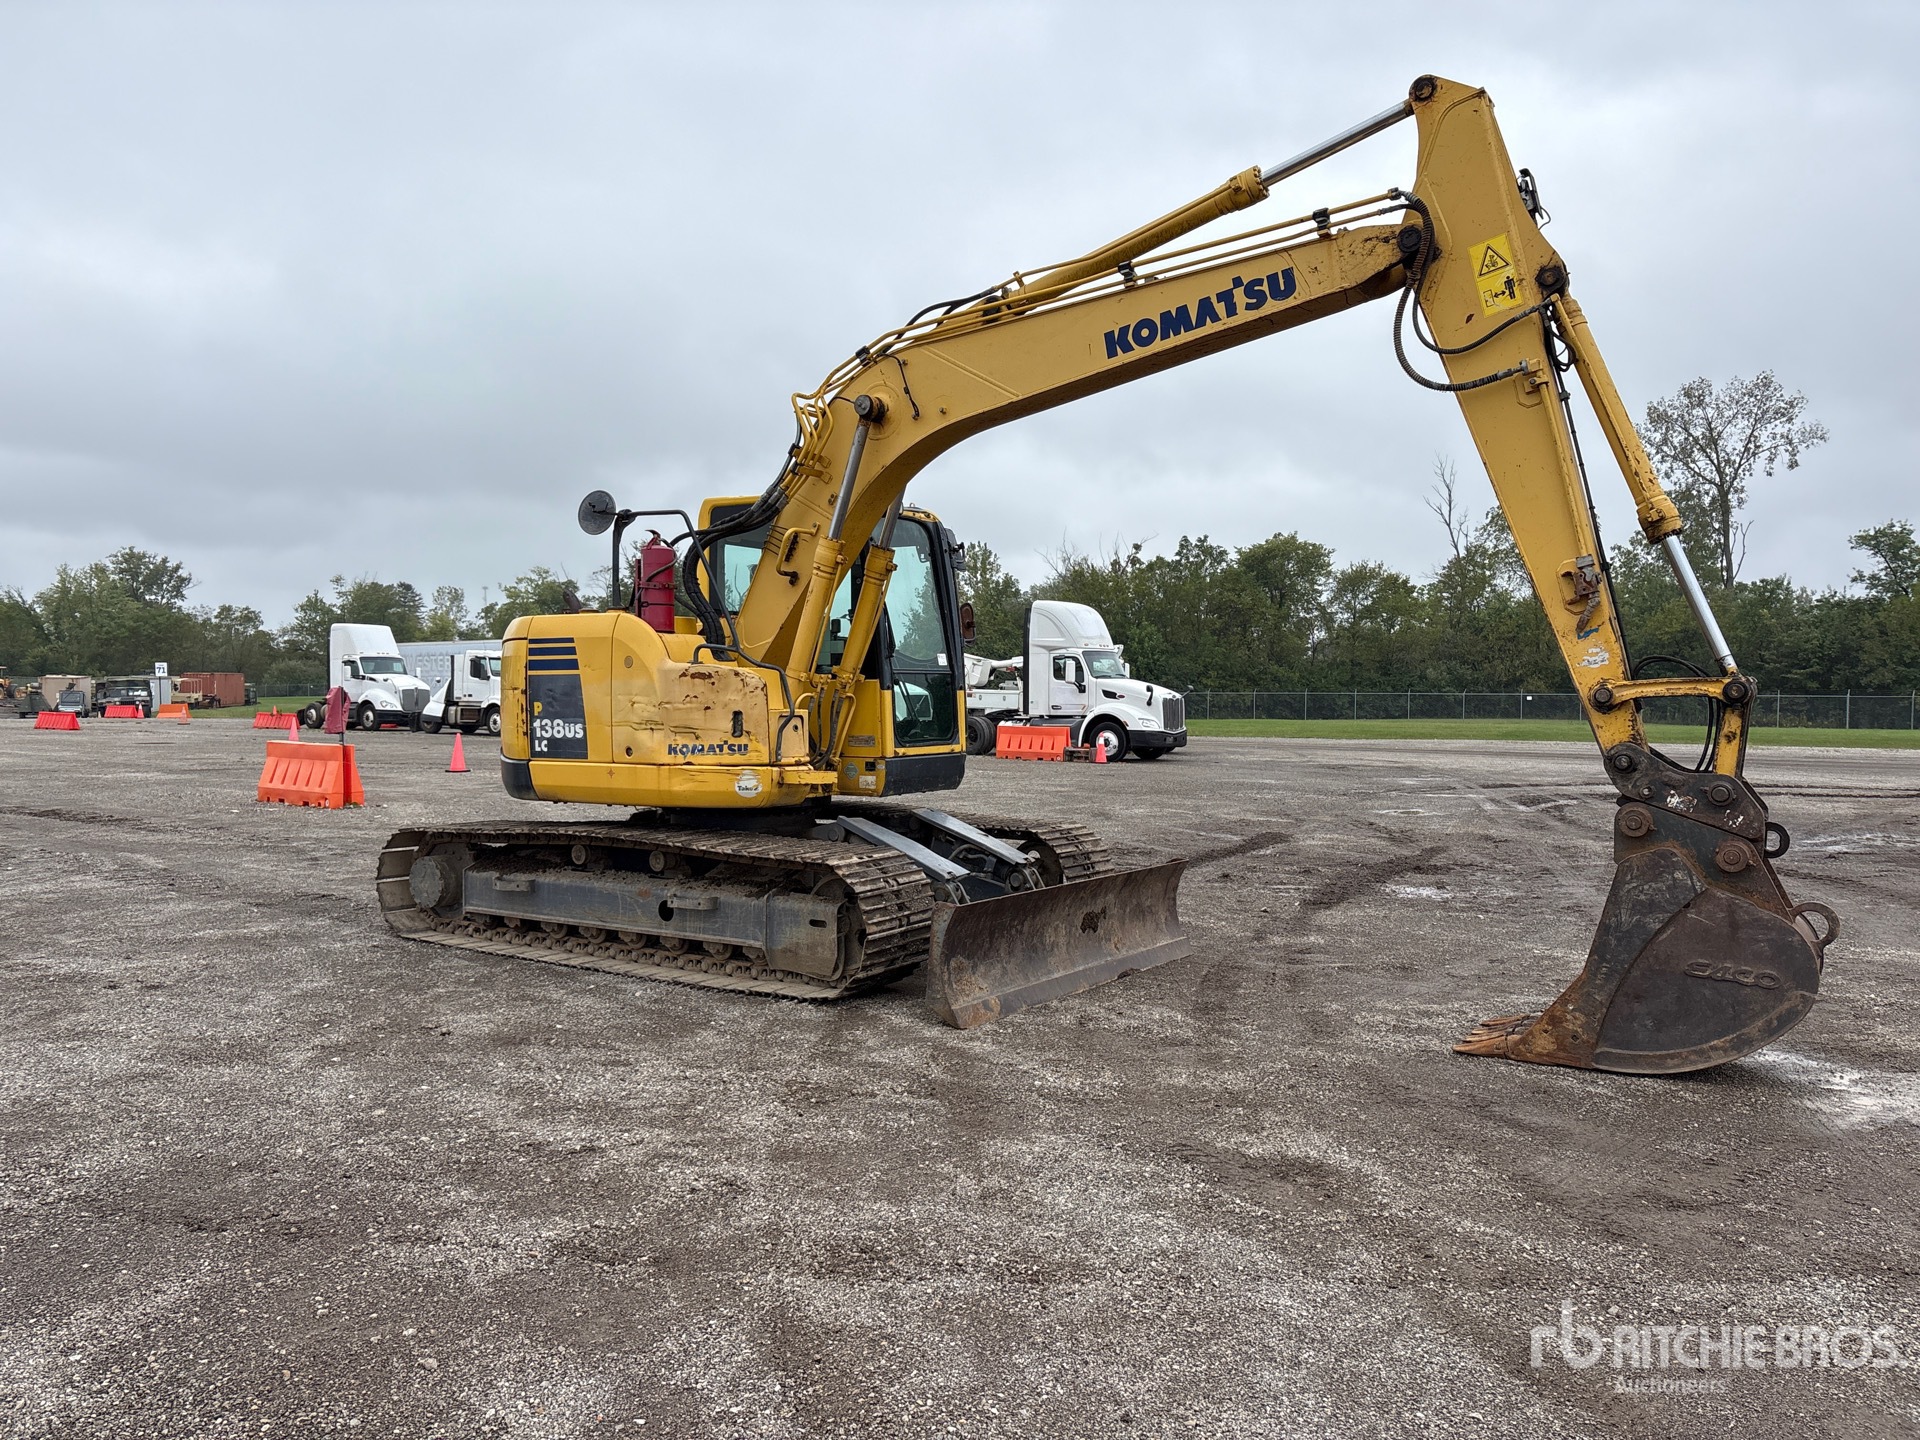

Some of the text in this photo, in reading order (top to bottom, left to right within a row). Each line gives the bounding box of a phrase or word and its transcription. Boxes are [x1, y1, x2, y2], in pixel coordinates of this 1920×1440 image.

[1104, 267, 1297, 359] KOMATSU
[156, 666, 166, 674] 71
[533, 701, 543, 716] P
[533, 718, 584, 739] 138US
[534, 739, 548, 752] LC
[667, 740, 749, 756] KOMATSU
